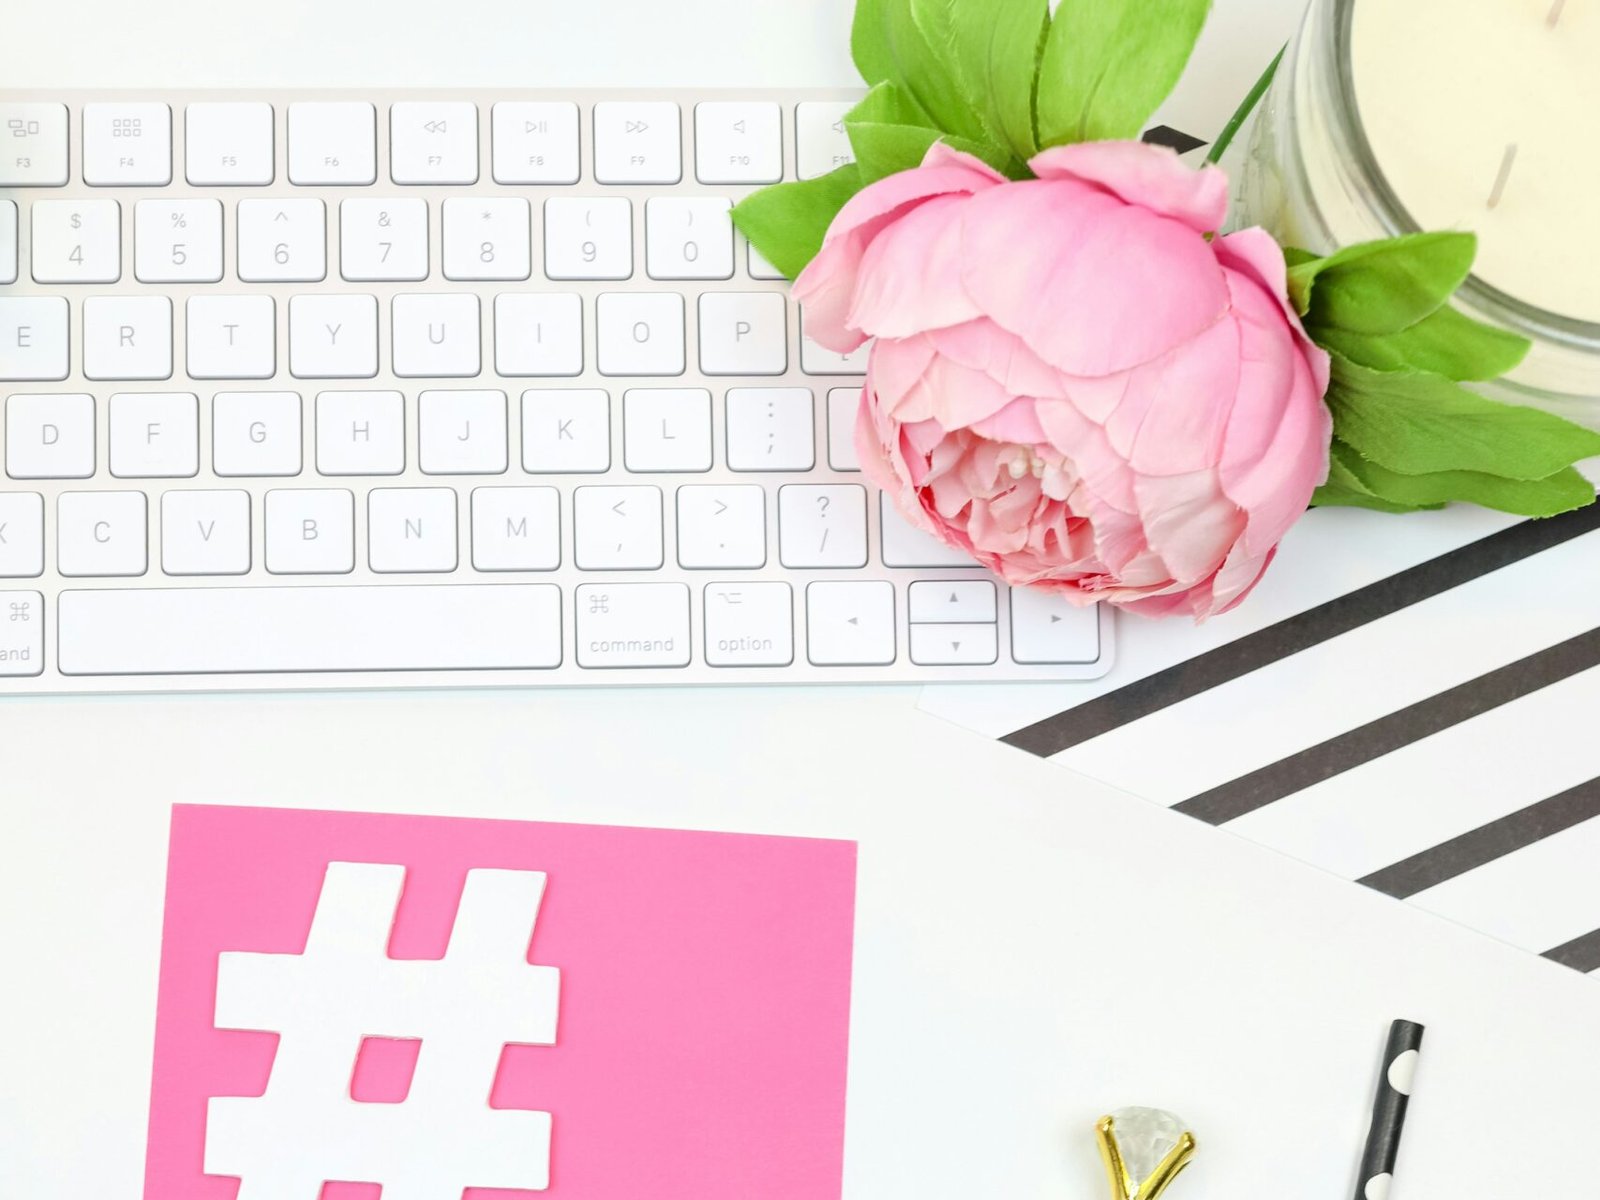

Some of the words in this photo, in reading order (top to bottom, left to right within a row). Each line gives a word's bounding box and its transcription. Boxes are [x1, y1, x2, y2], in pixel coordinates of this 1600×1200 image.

[16, 158, 31, 168] F3
[120, 158, 134, 167] F4
[222, 156, 236, 166] F5
[325, 157, 339, 166] F6
[428, 156, 442, 165] F7
[530, 156, 544, 165] F8
[631, 156, 645, 165] F9
[730, 156, 750, 165] F10
[71, 213, 81, 229] $
[171, 213, 187, 228] %
[378, 212, 391, 227] &
[69, 245, 84, 265] 4
[172, 244, 186, 265] 5
[274, 243, 289, 264] 6
[379, 242, 392, 263] 7
[480, 242, 494, 263] 8
[582, 241, 596, 262] 9
[683, 241, 698, 262] 0
[18, 326, 31, 347] E
[120, 326, 135, 347] R
[223, 324, 239, 345] T
[326, 324, 341, 345] Y
[429, 323, 445, 344] U
[633, 322, 650, 343] O
[736, 321, 751, 342] P
[43, 424, 59, 445] D
[147, 423, 160, 444] F
[249, 421, 266, 443] G
[353, 421, 369, 441] H
[458, 420, 470, 441] J
[558, 419, 573, 440] K
[662, 419, 675, 439] L
[612, 500, 625, 516] <
[714, 500, 727, 515] >
[817, 496, 830, 517] ?
[94, 521, 110, 543] C
[198, 520, 215, 541] V
[303, 519, 318, 540] B
[405, 518, 421, 539] N
[507, 517, 526, 538] M
[591, 638, 673, 652] command
[719, 636, 772, 653] option
